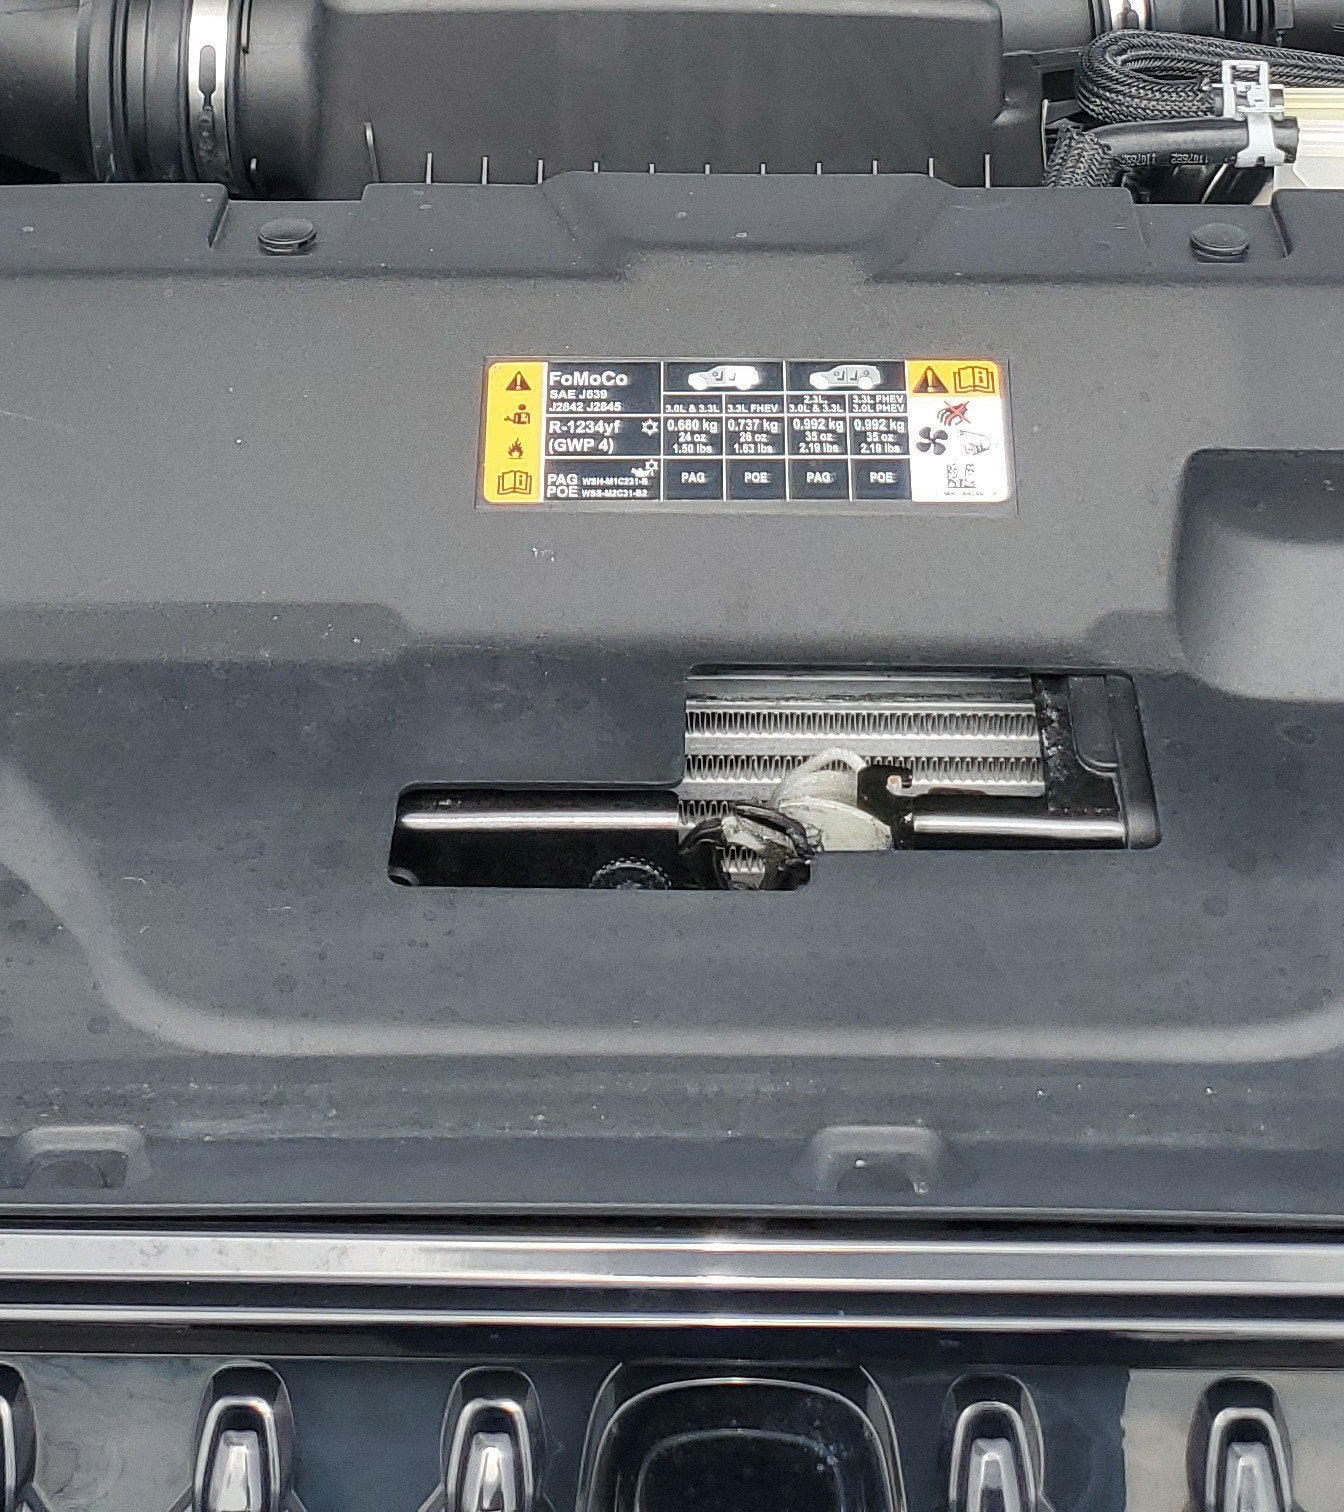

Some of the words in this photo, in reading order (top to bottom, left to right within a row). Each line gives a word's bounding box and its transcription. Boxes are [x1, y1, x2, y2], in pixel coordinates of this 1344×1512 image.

[549, 370, 628, 387] FoMoCo
[549, 389, 576, 400] SAE
[579, 389, 608, 400] J639
[549, 401, 584, 412] J2842
[665, 403, 687, 413] 3.0L
[688, 403, 697, 413] &
[699, 403, 720, 413] 3.3L
[727, 403, 749, 413] 3.3L
[788, 403, 810, 413] 3.0L
[812, 403, 821, 413] &
[822, 403, 844, 413] 3.3L
[852, 403, 875, 413] 3.0L
[549, 419, 622, 436] R-1234yf
[666, 418, 700, 431] 0.680
[702, 418, 718, 433] kg
[727, 418, 760, 431] 0.737
[762, 418, 779, 433] kg
[792, 418, 826, 430] 0.992
[828, 417, 844, 433] kg
[853, 418, 887, 431] 0.992
[889, 418, 905, 433] kg
[678, 432, 692, 442] 24
[693, 433, 707, 442] oz
[739, 432, 753, 442] 26
[754, 433, 768, 442] oz
[805, 431, 818, 441] 35
[819, 433, 834, 441] oz
[866, 431, 879, 442] 35
[880, 433, 894, 442] oz
[548, 437, 595, 455] (GWP
[598, 437, 615, 455] 4)
[672, 443, 694, 454] 1.50
[696, 443, 713, 454] lbs
[733, 443, 755, 454] 1.63
[757, 443, 774, 454] lbs
[799, 442, 821, 453] 2.19
[822, 442, 839, 453] lbs
[860, 443, 882, 454] 2.19
[884, 443, 901, 454] lbs
[546, 473, 579, 485] PAG
[681, 471, 706, 483] PAG
[744, 471, 768, 483] POE
[806, 471, 831, 483] PAG
[869, 471, 894, 483] POE
[546, 485, 579, 498] POE
